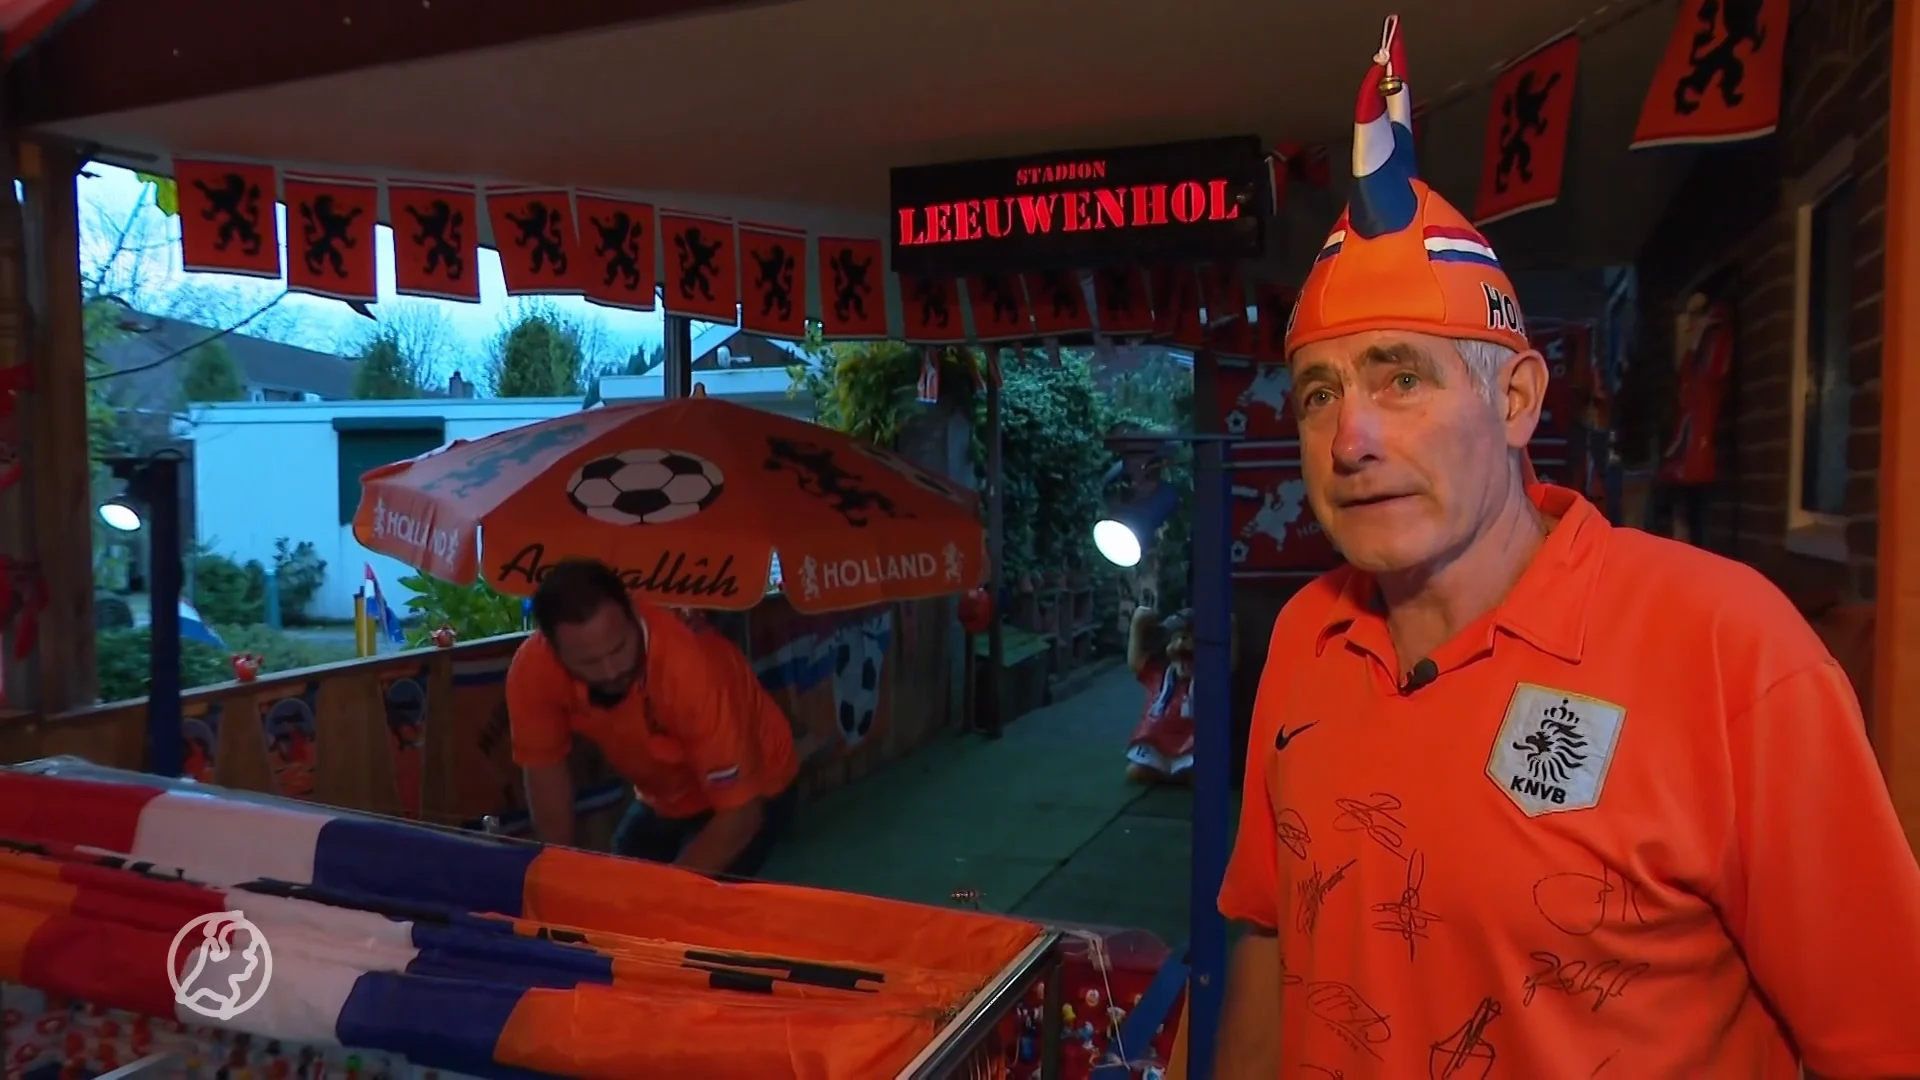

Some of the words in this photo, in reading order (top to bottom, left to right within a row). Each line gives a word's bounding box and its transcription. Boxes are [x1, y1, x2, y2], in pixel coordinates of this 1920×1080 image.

[1016, 160, 1107, 186] STADION
[898, 179, 1239, 246] LEEUWENHOL
[1480, 281, 1528, 338] HO
[823, 552, 938, 589] HOLLAND
[1510, 775, 1566, 804] KNVB
